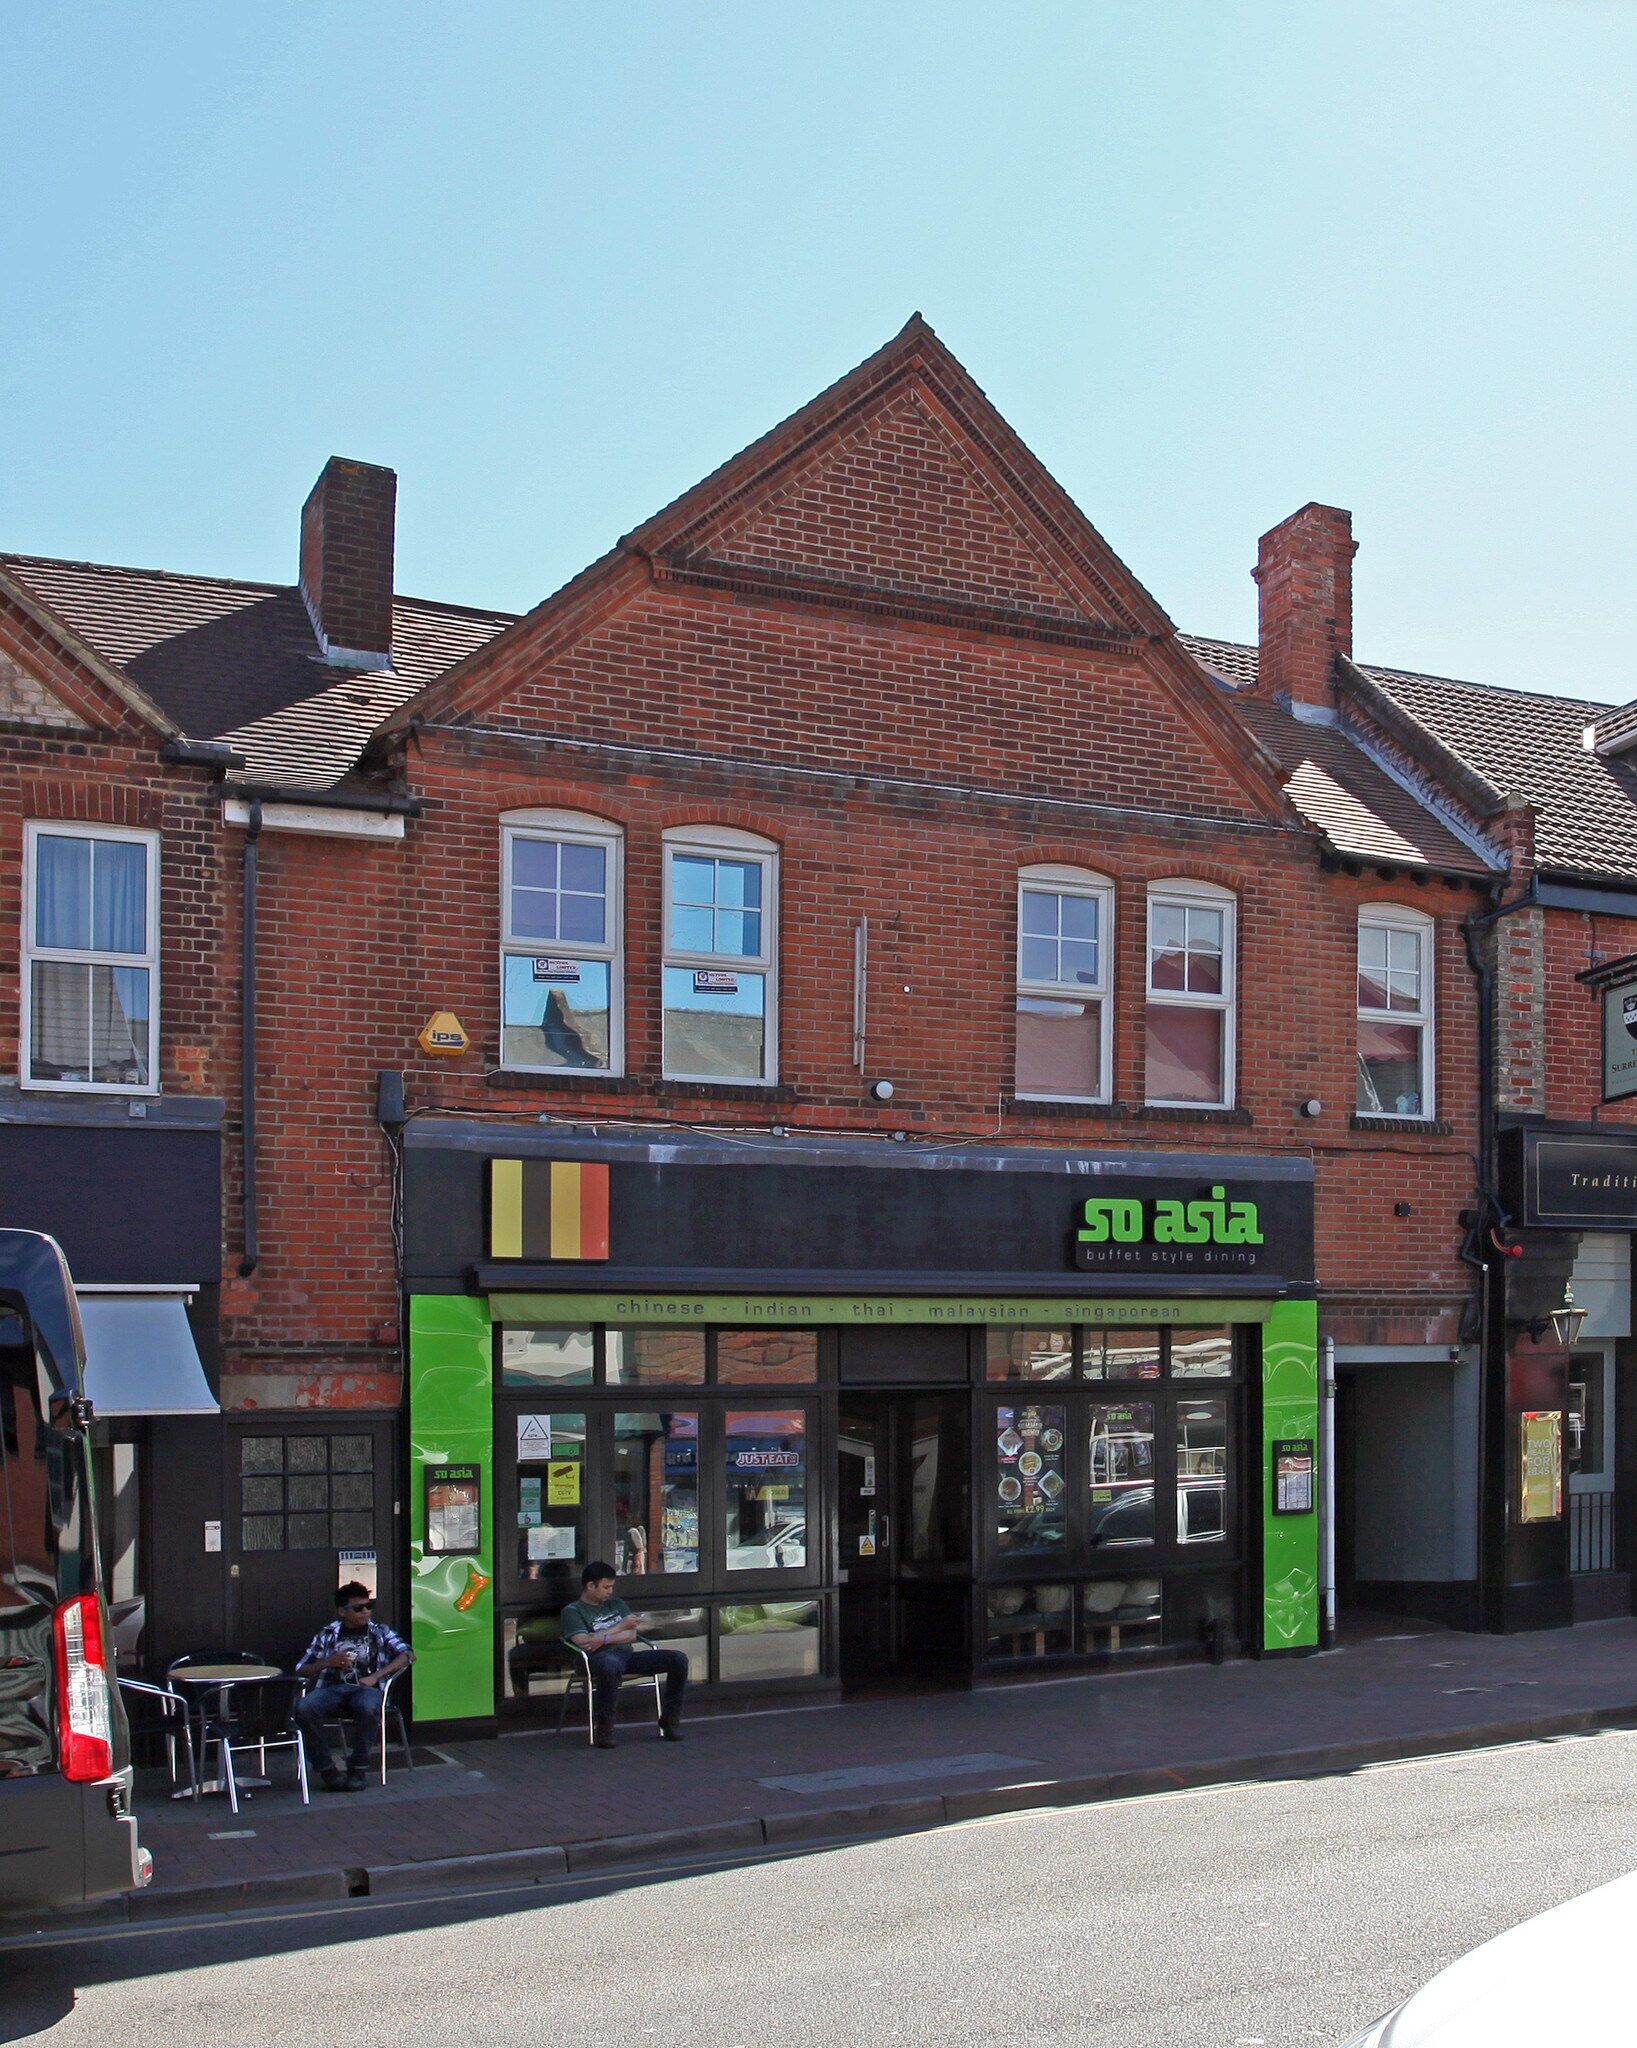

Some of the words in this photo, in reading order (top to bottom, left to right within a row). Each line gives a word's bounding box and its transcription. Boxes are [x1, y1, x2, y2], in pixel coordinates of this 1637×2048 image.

[1571, 1173, 1637, 1188] Traditi
[1078, 1198, 1143, 1243] so
[1154, 1185, 1264, 1244] asia
[1086, 1249, 1141, 1261] buffet
[1151, 1250, 1194, 1264] style
[1204, 1250, 1256, 1264] dining
[616, 1299, 704, 1314] chinese
[744, 1301, 812, 1316] indian
[853, 1302, 894, 1316] thai
[928, 1303, 1029, 1321] malaysian
[1065, 1304, 1181, 1320] singaporean
[1527, 1440, 1551, 1448] TWO
[740, 1454, 766, 1464] JUST
[769, 1455, 789, 1464] EAT
[1527, 1457, 1550, 1466] FOR
[434, 1470, 447, 1478] so
[450, 1467, 474, 1478] asia
[1026, 1505, 1044, 1513] £2.99
